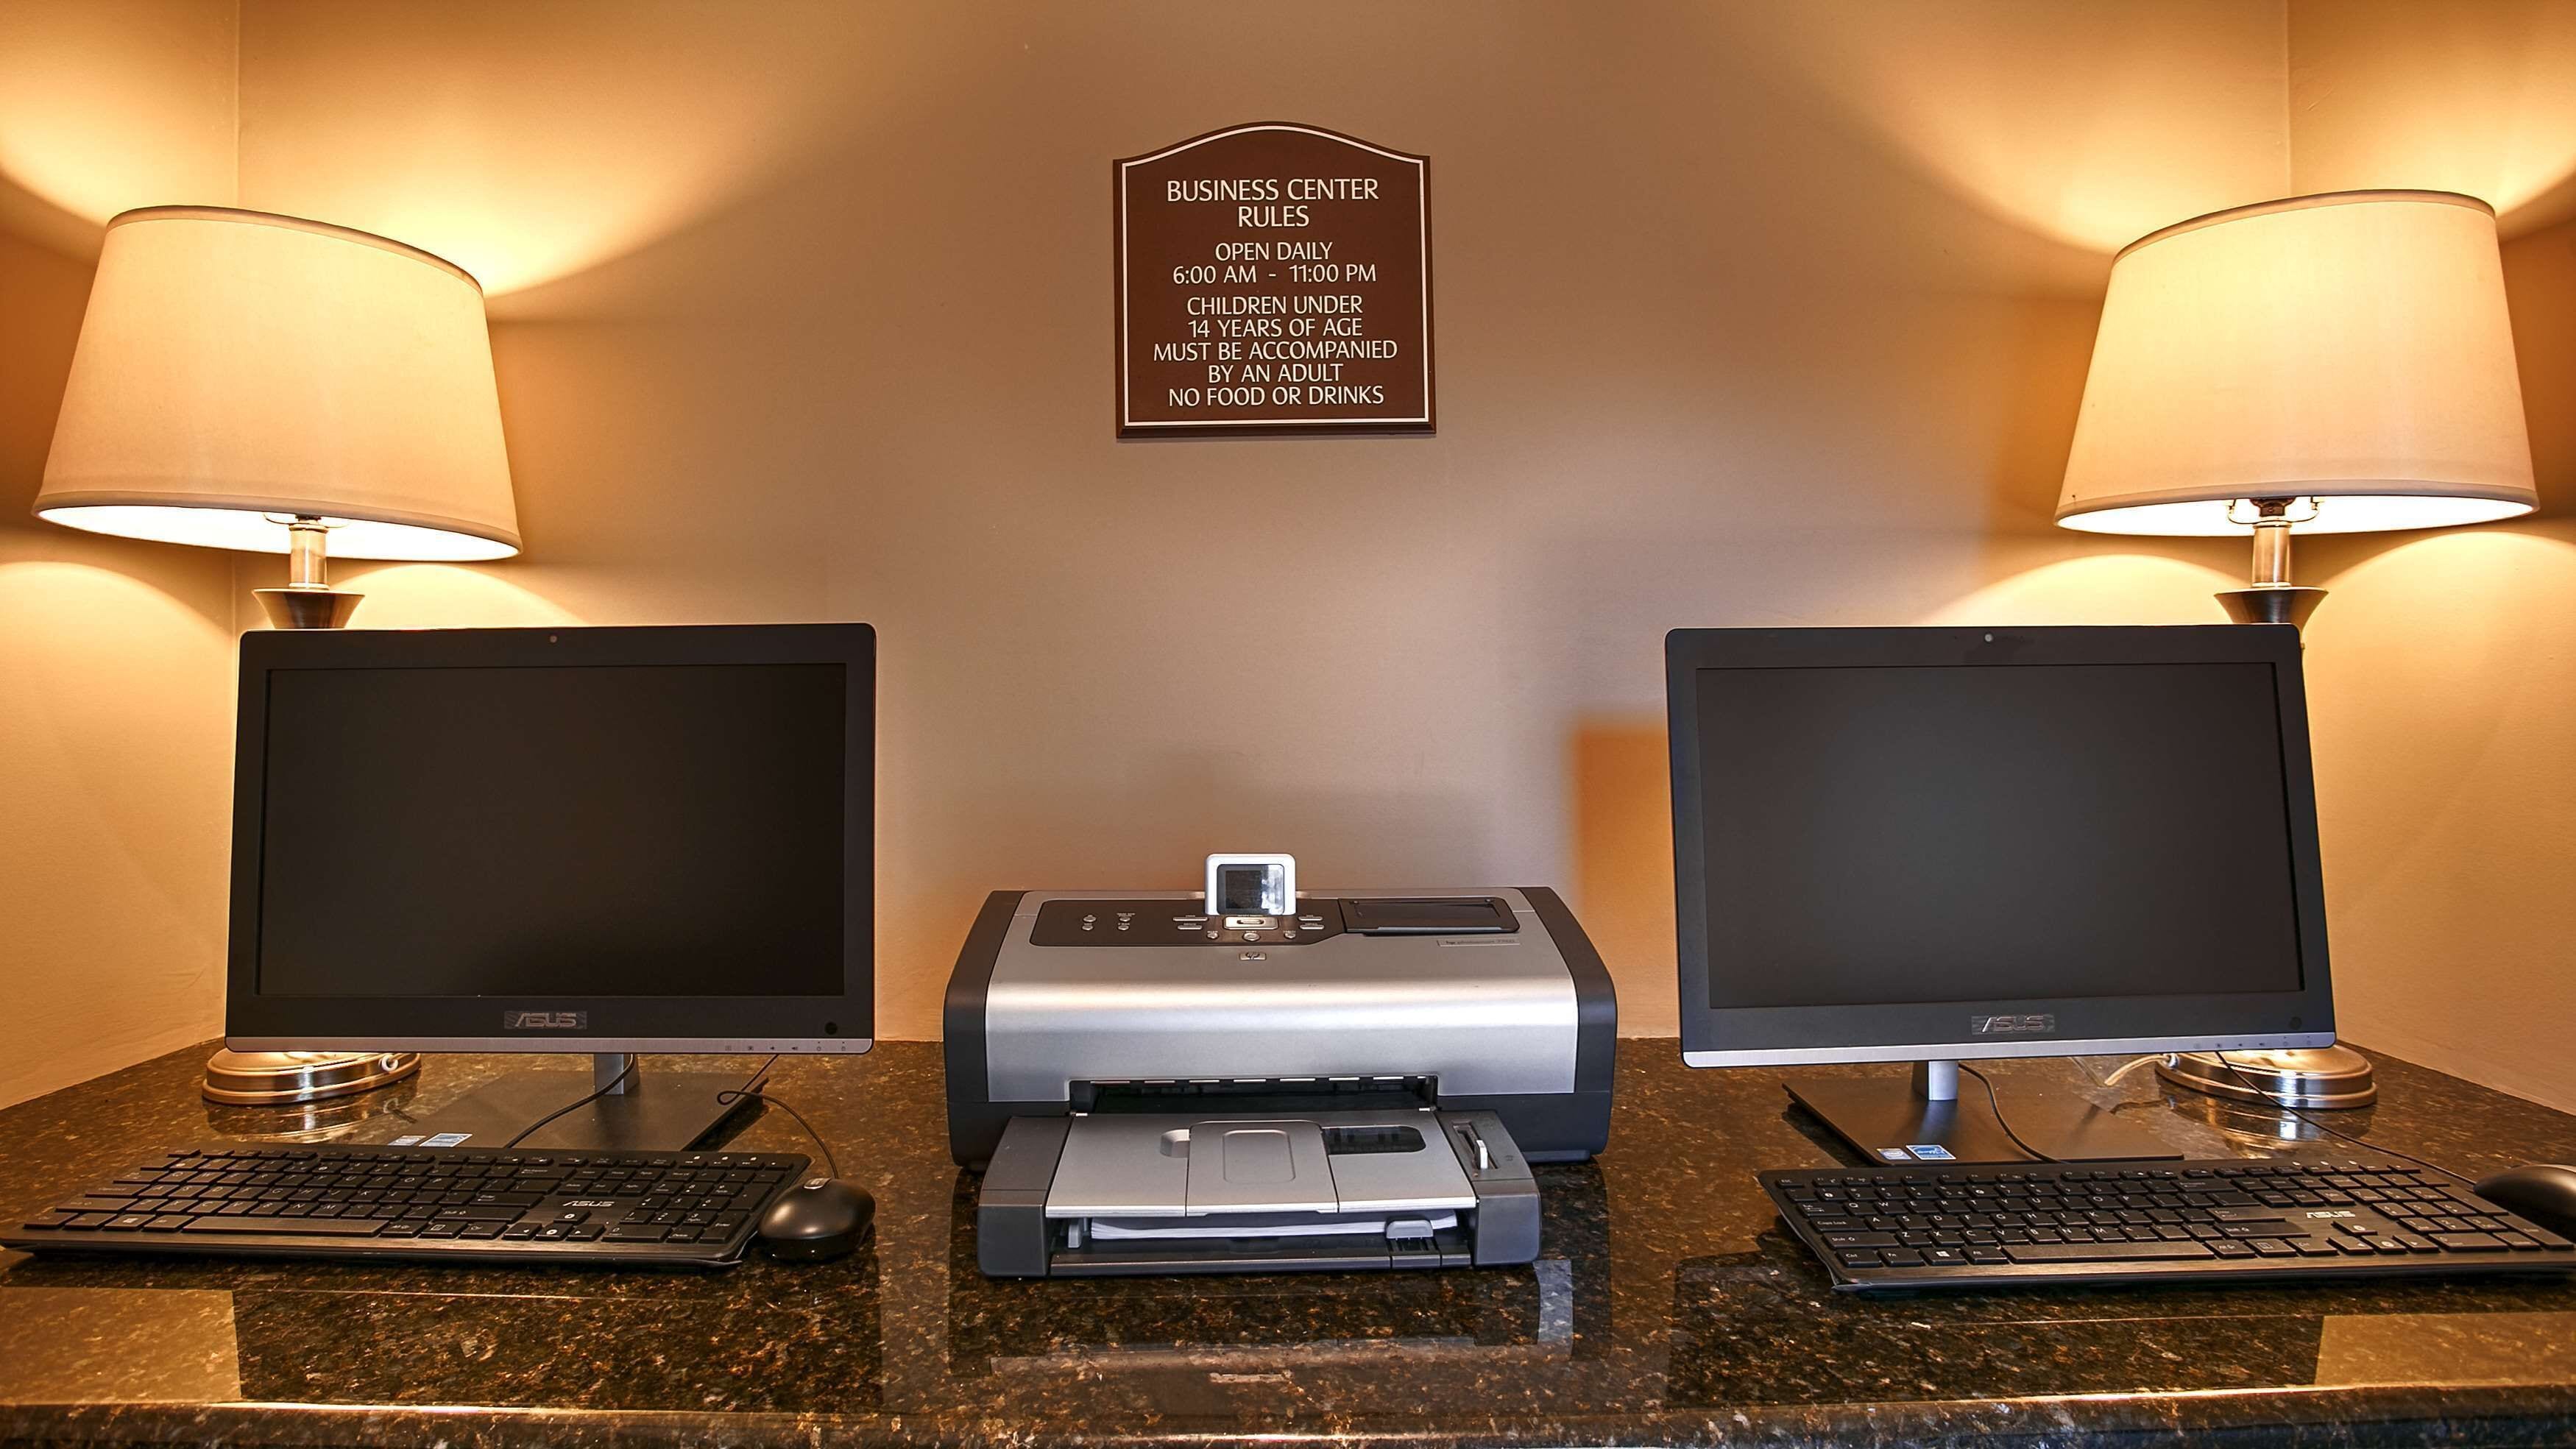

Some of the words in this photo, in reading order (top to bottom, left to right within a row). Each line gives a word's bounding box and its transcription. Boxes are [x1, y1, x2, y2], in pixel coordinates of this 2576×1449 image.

[1167, 179, 1279, 202] BUSINESS
[1287, 178, 1379, 200] CENTER
[1238, 205, 1309, 227] RULES
[1215, 242, 1270, 261] OPEN
[1277, 241, 1333, 261] DAILY
[1173, 265, 1217, 284] 6:00
[1223, 265, 1257, 283] AM
[1289, 263, 1339, 283] 11:00
[1346, 263, 1376, 282] PM
[1187, 296, 1287, 316] CHILDREN
[1294, 295, 1363, 314] UNDER
[1188, 319, 1211, 339] 14
[1217, 318, 1282, 338] YEARS
[1289, 318, 1316, 337] OF
[1323, 317, 1363, 336] AGE
[1153, 342, 1211, 361] MUST
[1218, 341, 1242, 361] BE
[1248, 340, 1398, 360] ACCOMPANIED
[1209, 364, 1234, 383] BY
[1241, 364, 1270, 383] AN
[1277, 363, 1344, 383] ADULT
[1169, 388, 1200, 407] NO
[1207, 386, 1265, 406] FOOD
[1272, 386, 1302, 405] OR
[1309, 385, 1384, 405] DRINKS
[514, 1012, 577, 1027] ASUS
[1981, 1016, 2044, 1032] ASUS
[2306, 1211, 2356, 1219] ASUS
